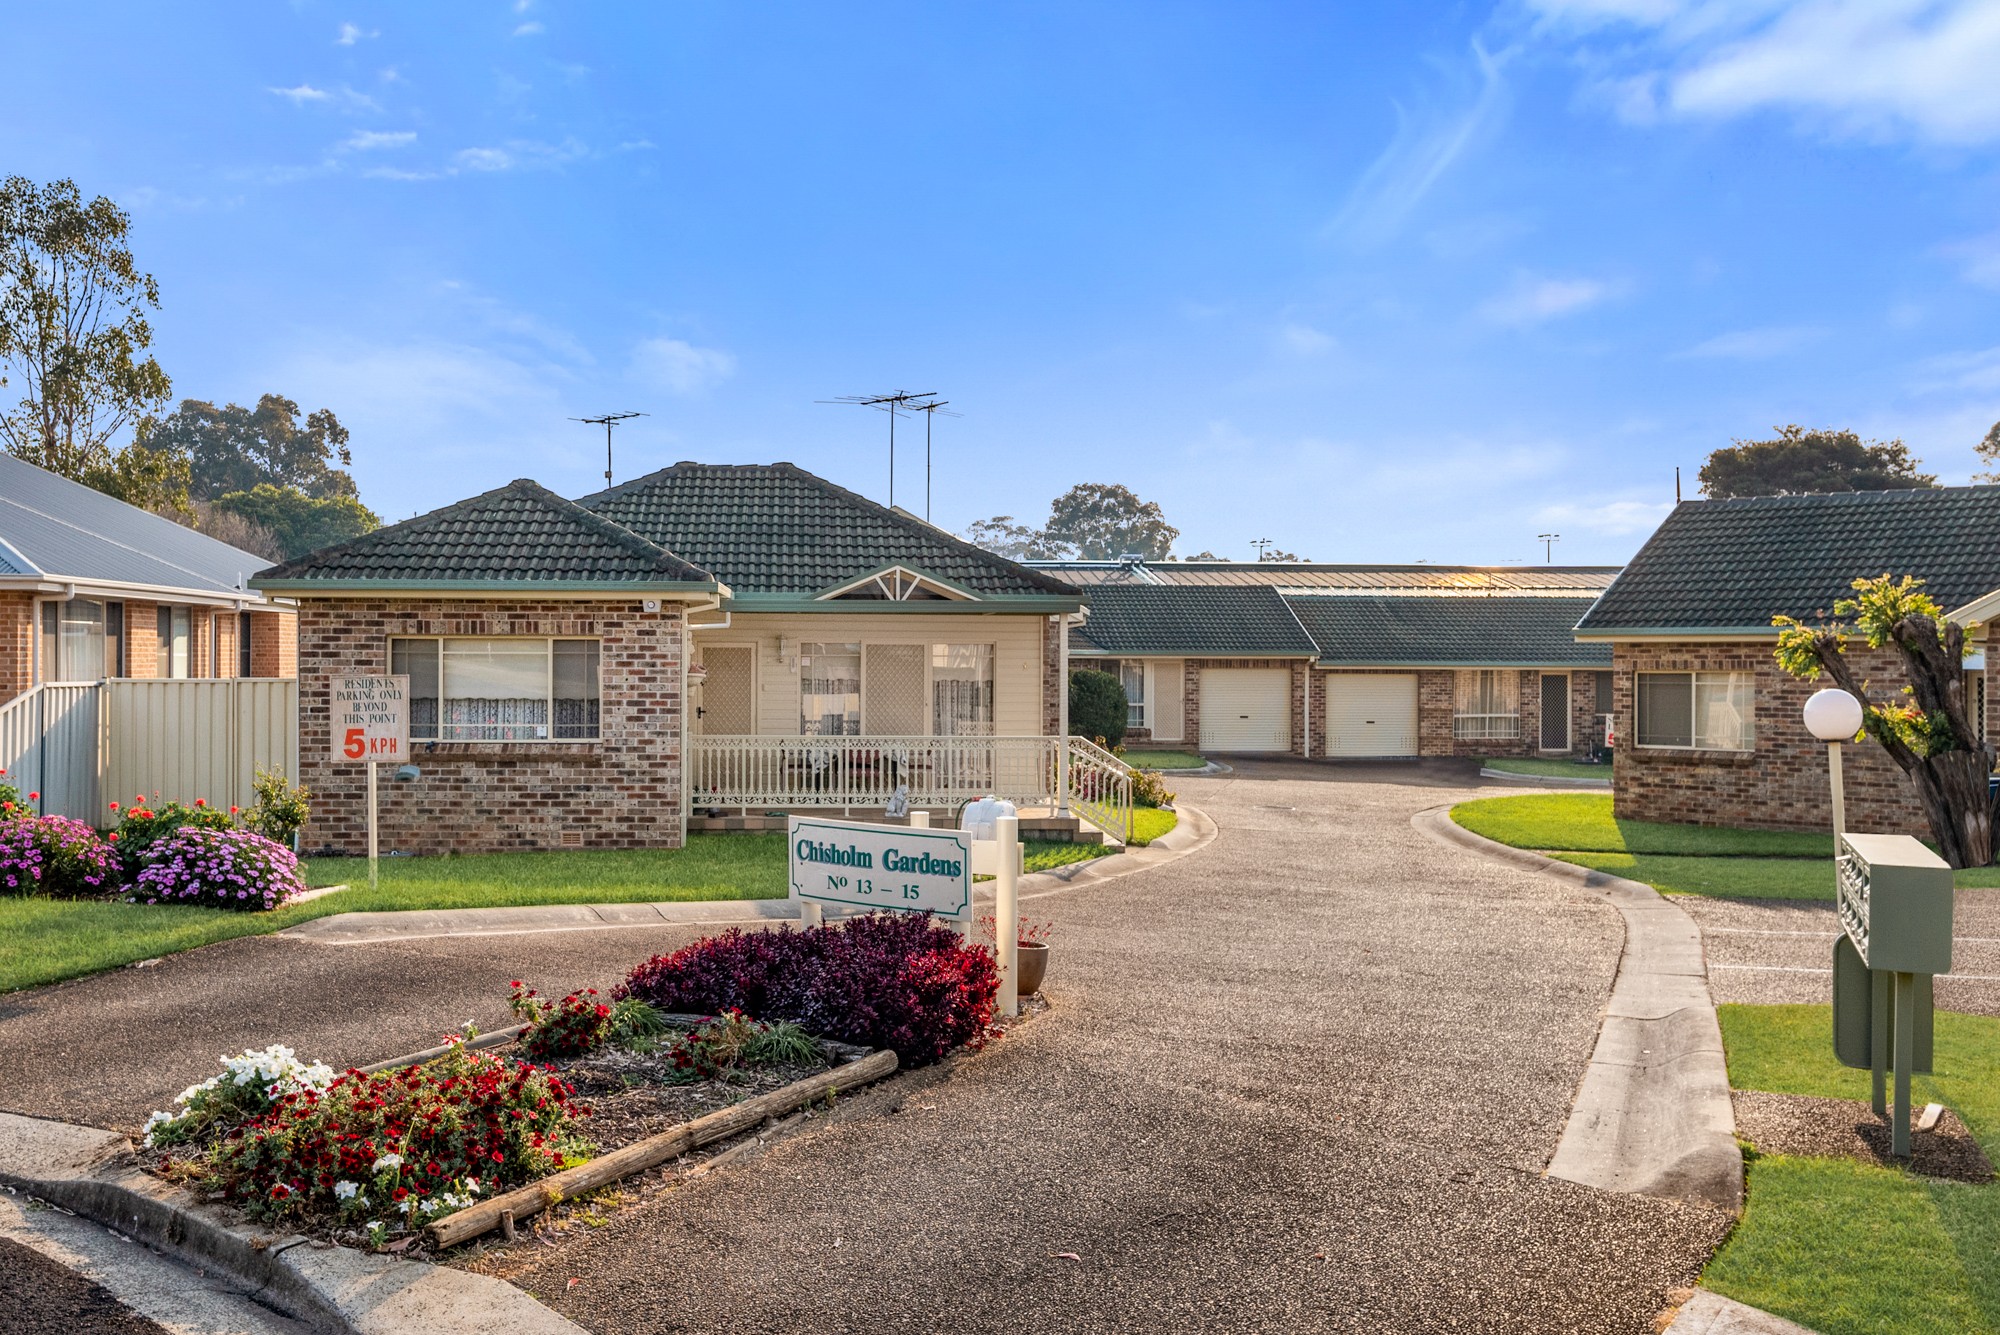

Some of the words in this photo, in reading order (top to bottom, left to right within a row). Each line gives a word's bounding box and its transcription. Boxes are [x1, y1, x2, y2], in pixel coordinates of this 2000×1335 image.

[344, 678, 395, 689] RESIDENTS
[336, 690, 375, 701] PARKING
[379, 690, 403, 700] ONLY
[353, 702, 388, 712] BEYOND
[343, 713, 365, 724] THIS
[369, 713, 397, 723] POINT
[343, 728, 366, 759] 5
[370, 737, 397, 754] KPH
[796, 838, 873, 869] Chisholm
[882, 848, 962, 878] Gardens
[856, 879, 873, 895] 13
[902, 883, 920, 900] 15
